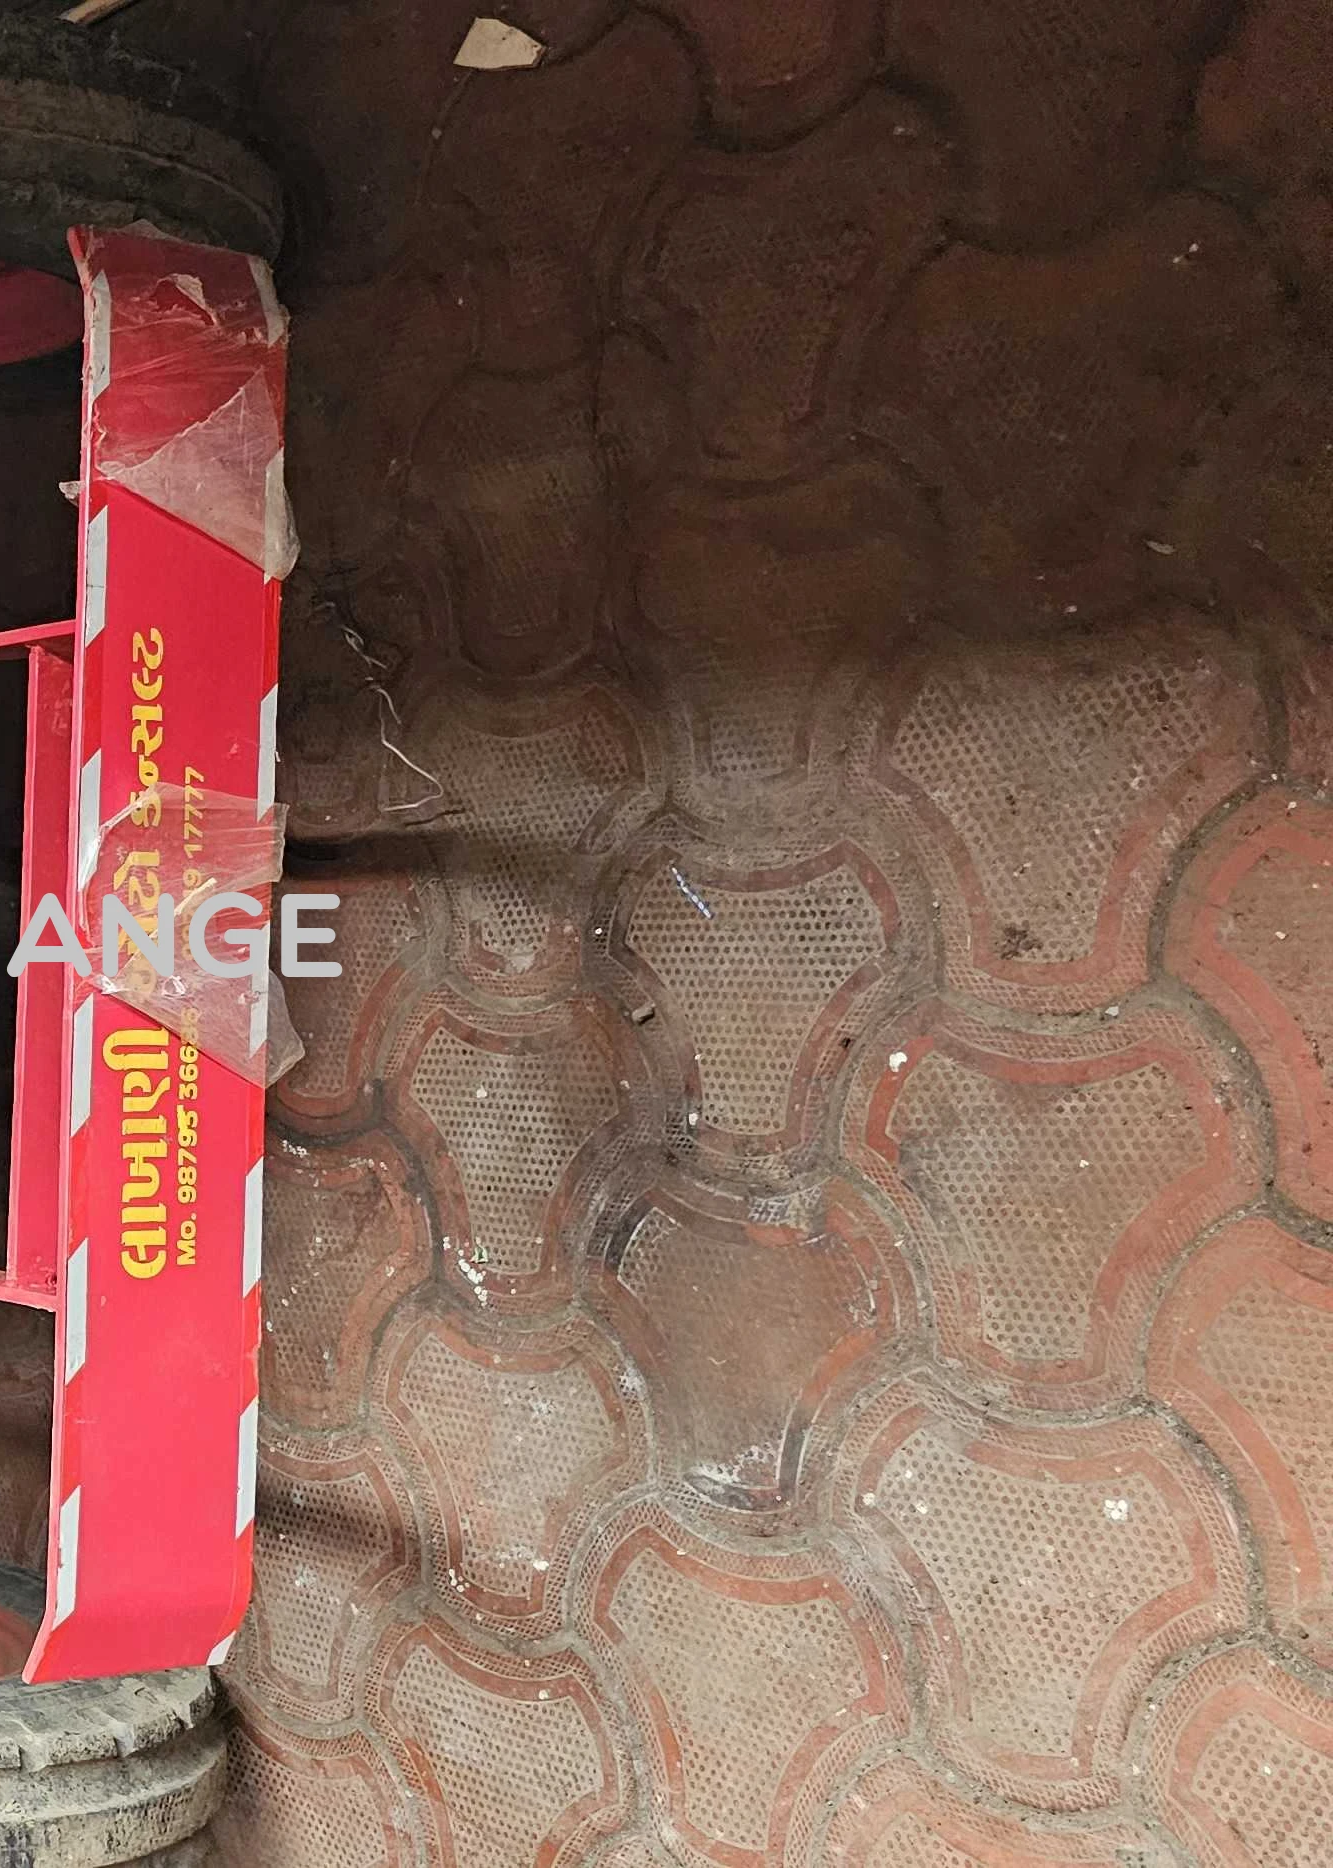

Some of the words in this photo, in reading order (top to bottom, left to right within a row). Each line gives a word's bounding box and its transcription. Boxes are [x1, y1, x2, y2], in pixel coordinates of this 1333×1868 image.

[130, 627, 164, 828] કન્સલ્ટ
[183, 766, 205, 859] 17777
[102, 1027, 171, 1279] લાખાણી
[177, 1212, 198, 1265] Mo.
